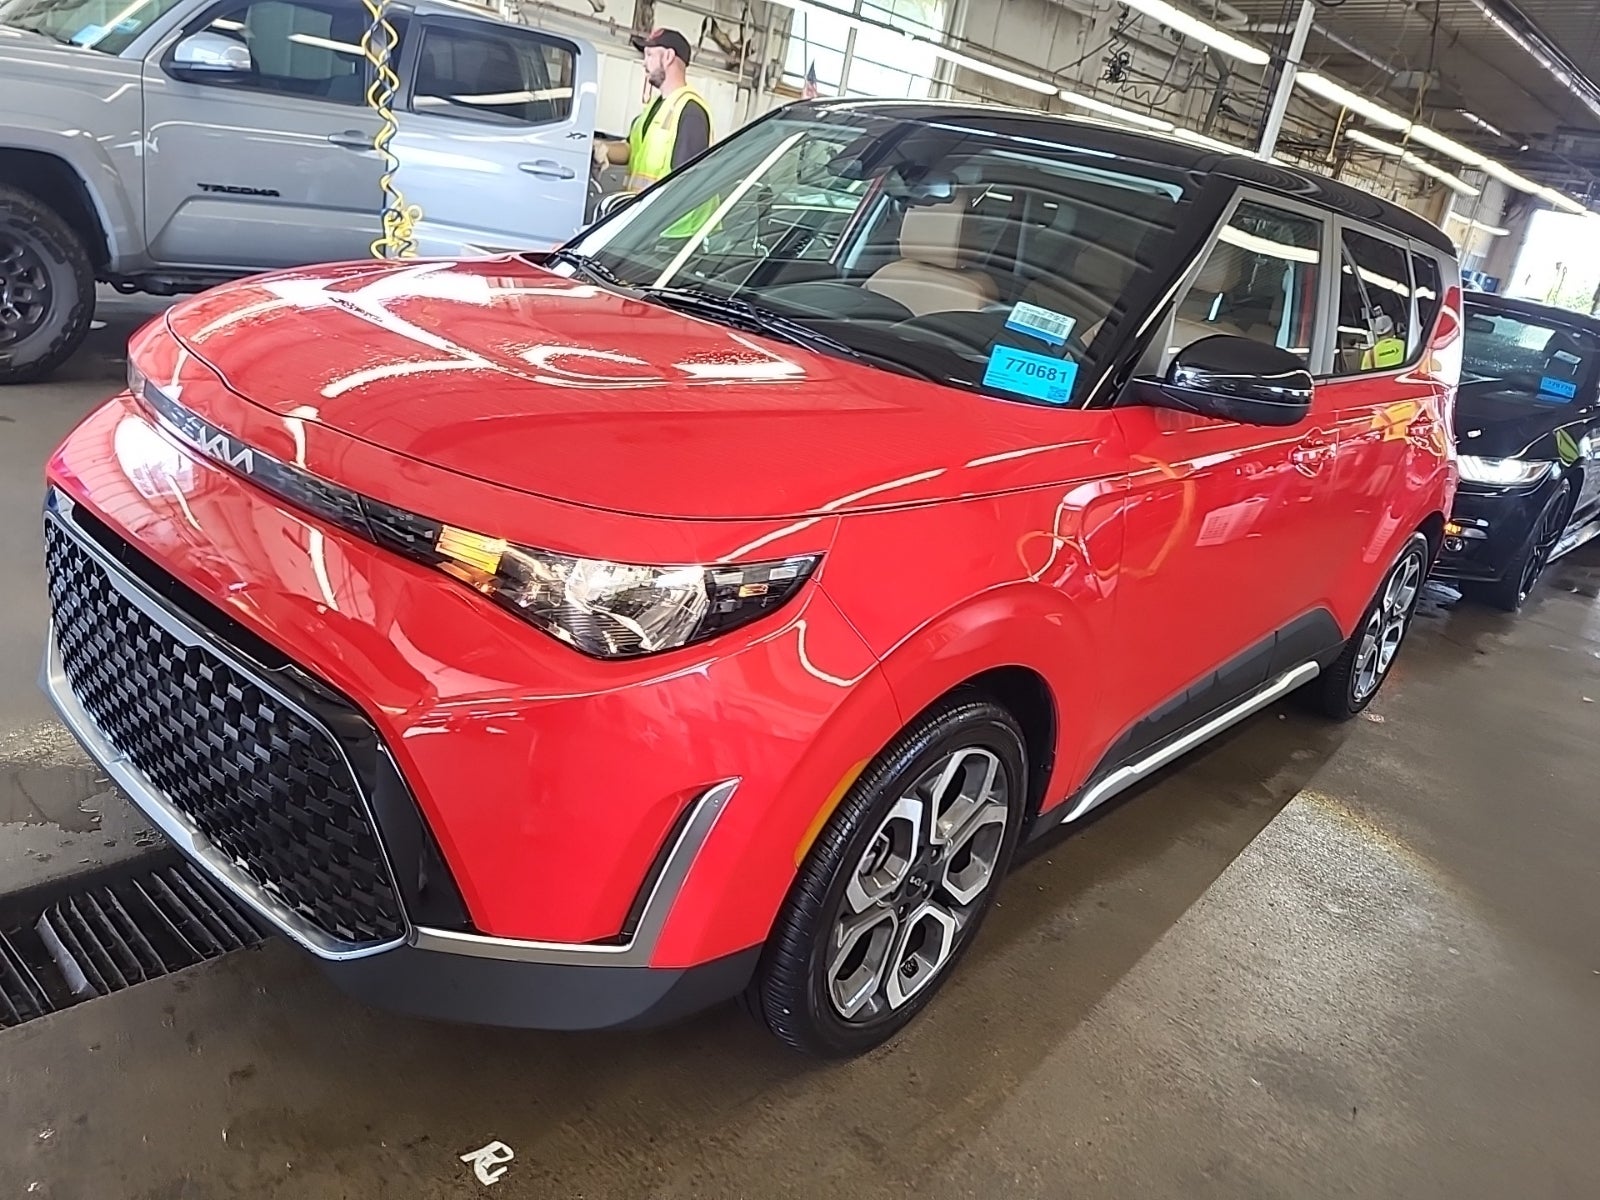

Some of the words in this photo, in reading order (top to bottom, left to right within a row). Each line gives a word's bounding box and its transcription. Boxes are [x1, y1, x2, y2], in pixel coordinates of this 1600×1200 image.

[197, 183, 280, 197] TACOMA
[1005, 357, 1068, 383] 770681
[199, 426, 254, 475] KIA
